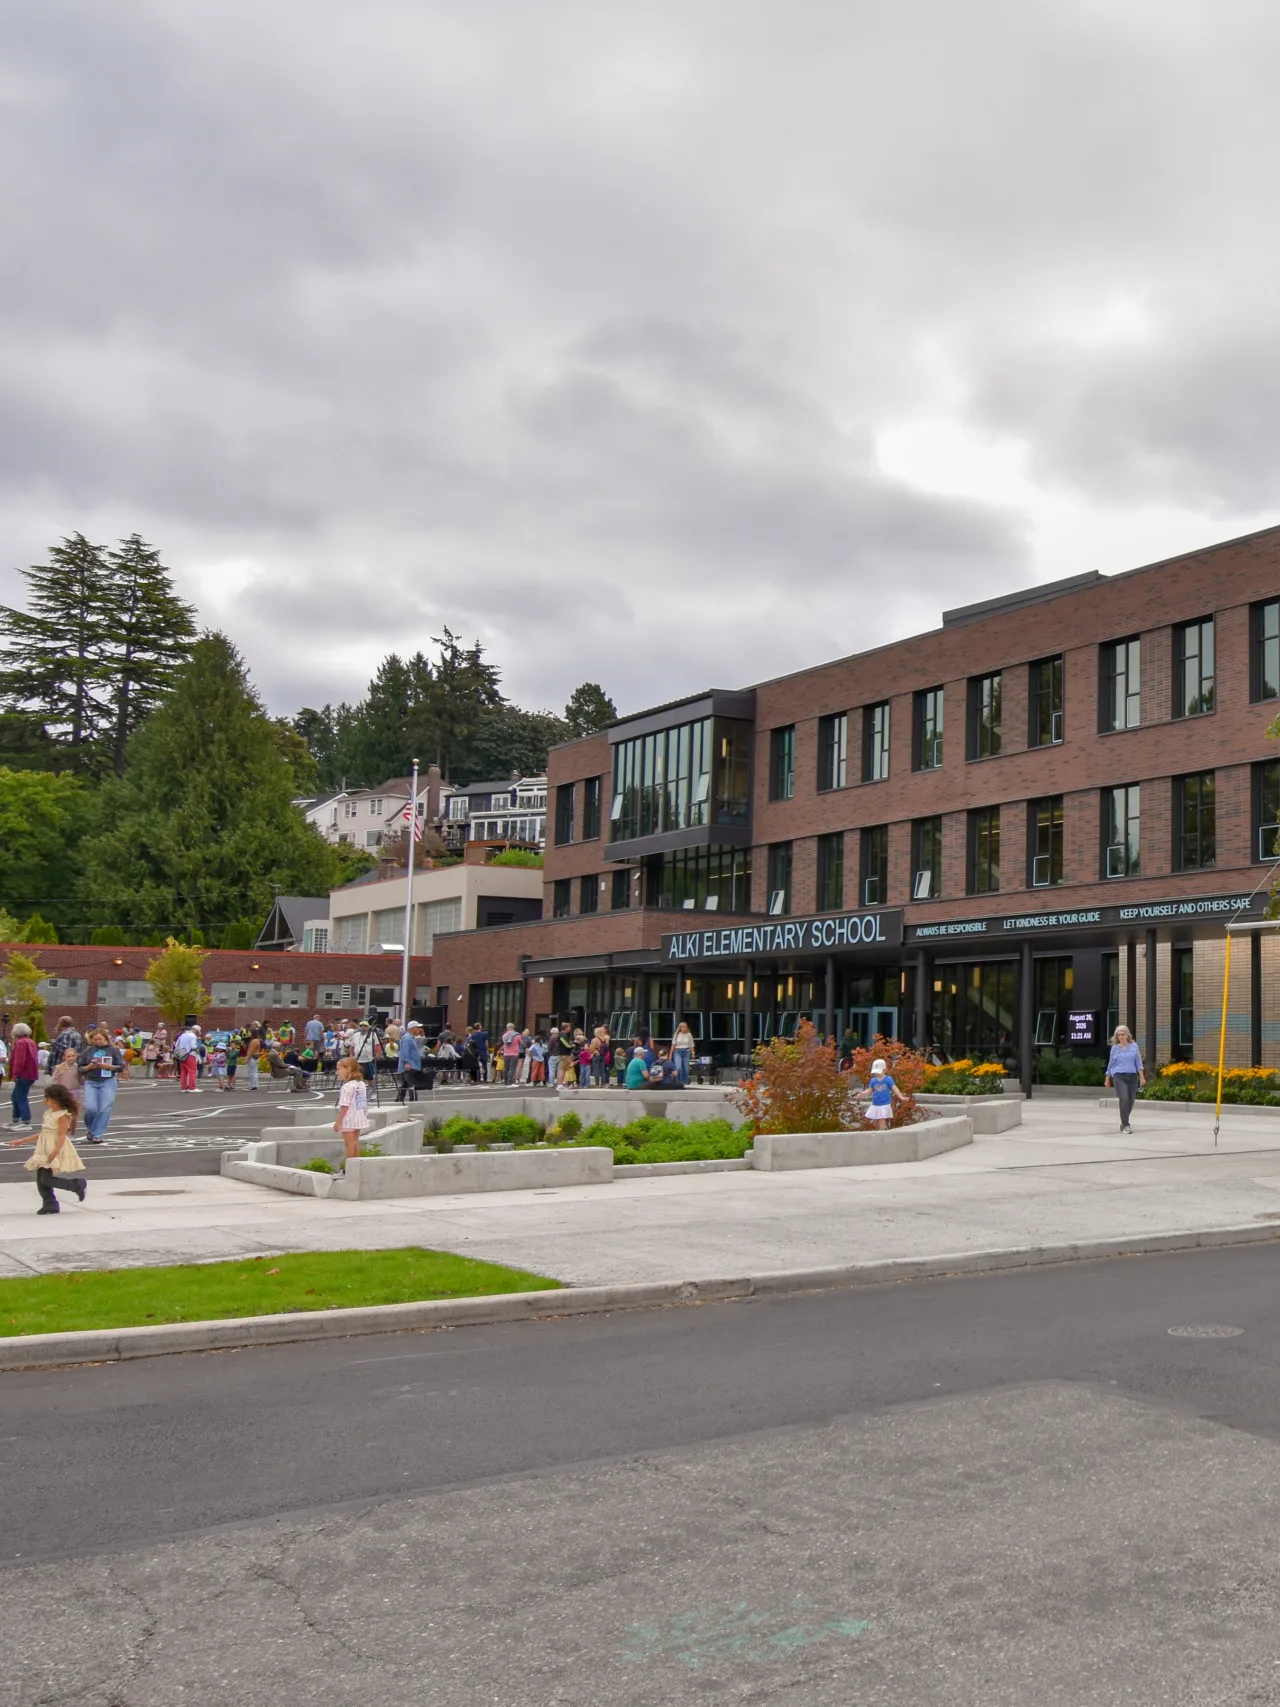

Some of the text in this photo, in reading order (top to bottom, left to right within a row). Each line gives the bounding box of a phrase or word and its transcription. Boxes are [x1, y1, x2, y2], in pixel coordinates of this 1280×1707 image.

[1120, 897, 1251, 920] KEEP YOURSELF AND OTHERS SAFE
[916, 921, 988, 937] ALWAYS BE RESPONSIBLE
[1003, 911, 1101, 929] LET KINDNESS BE YOUR GUIDE
[669, 914, 886, 959] ALKI ELEMENTARY SCHOOL
[1069, 1014, 1085, 1022] August
